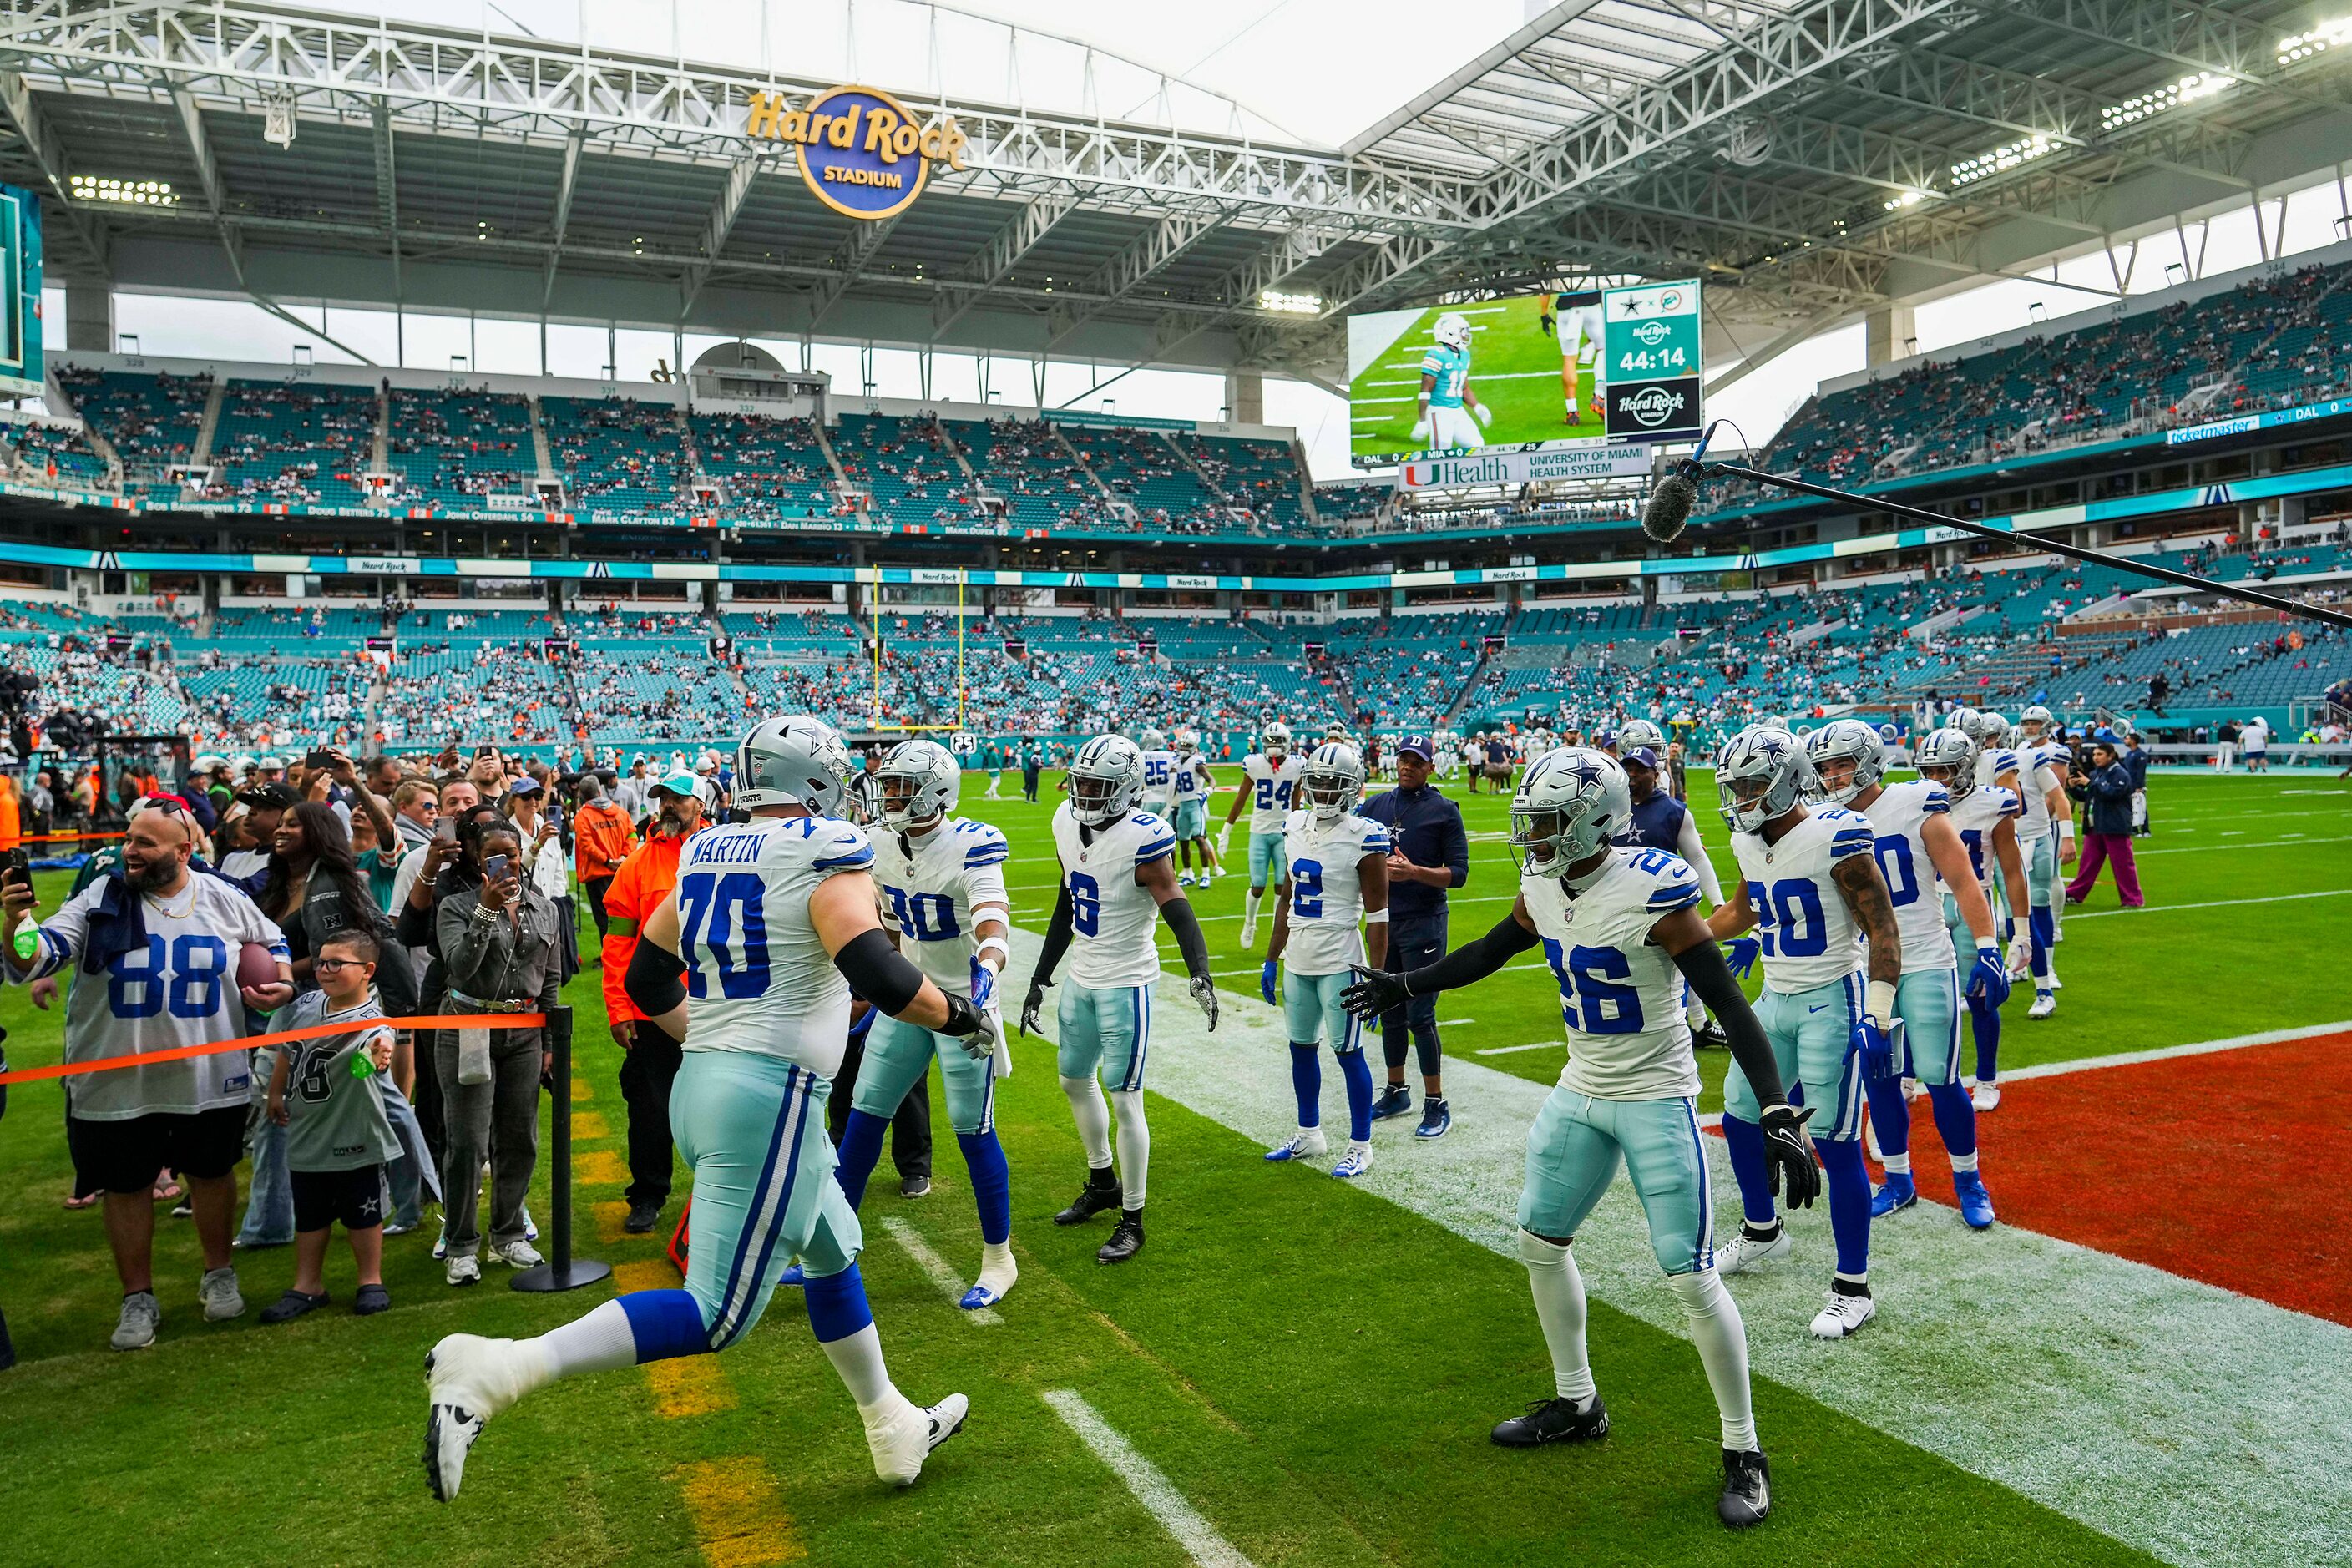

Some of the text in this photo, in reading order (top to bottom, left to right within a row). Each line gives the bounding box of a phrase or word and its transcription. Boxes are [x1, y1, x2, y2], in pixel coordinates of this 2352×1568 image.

[747, 91, 966, 171] Hard Rock
[823, 165, 903, 189] STADIUM
[1620, 347, 1686, 371] 44:14
[1619, 393, 1684, 412] Hard Rock
[2296, 402, 2339, 419] DAL 0
[2172, 419, 2251, 444] ticketmaster
[1363, 453, 1399, 464] DAL 0
[1427, 448, 1463, 459] MIA 0
[1530, 448, 1643, 466] UNIVERSITY OF MIAMI
[1530, 463, 1612, 478] HEALTH SYSTEM
[592, 514, 675, 526] MARK CLAYTON 83
[833, 523, 842, 531] 13
[945, 526, 969, 534] MARK
[941, 573, 957, 582] Rock
[1193, 579, 1207, 588] Rock
[1510, 571, 1527, 581] Rock
[954, 736, 973, 751] 25
[1410, 736, 1423, 747] D
[1631, 747, 1643, 756] D
[1145, 761, 1169, 786] 25
[1257, 778, 1293, 810] 24
[690, 834, 768, 866] MARTIN
[1292, 858, 1323, 918] 2
[883, 884, 961, 942] 30
[1747, 878, 1828, 958] 20
[680, 872, 771, 999] 70
[107, 933, 227, 1019] 88
[1540, 933, 1645, 1034] 26
